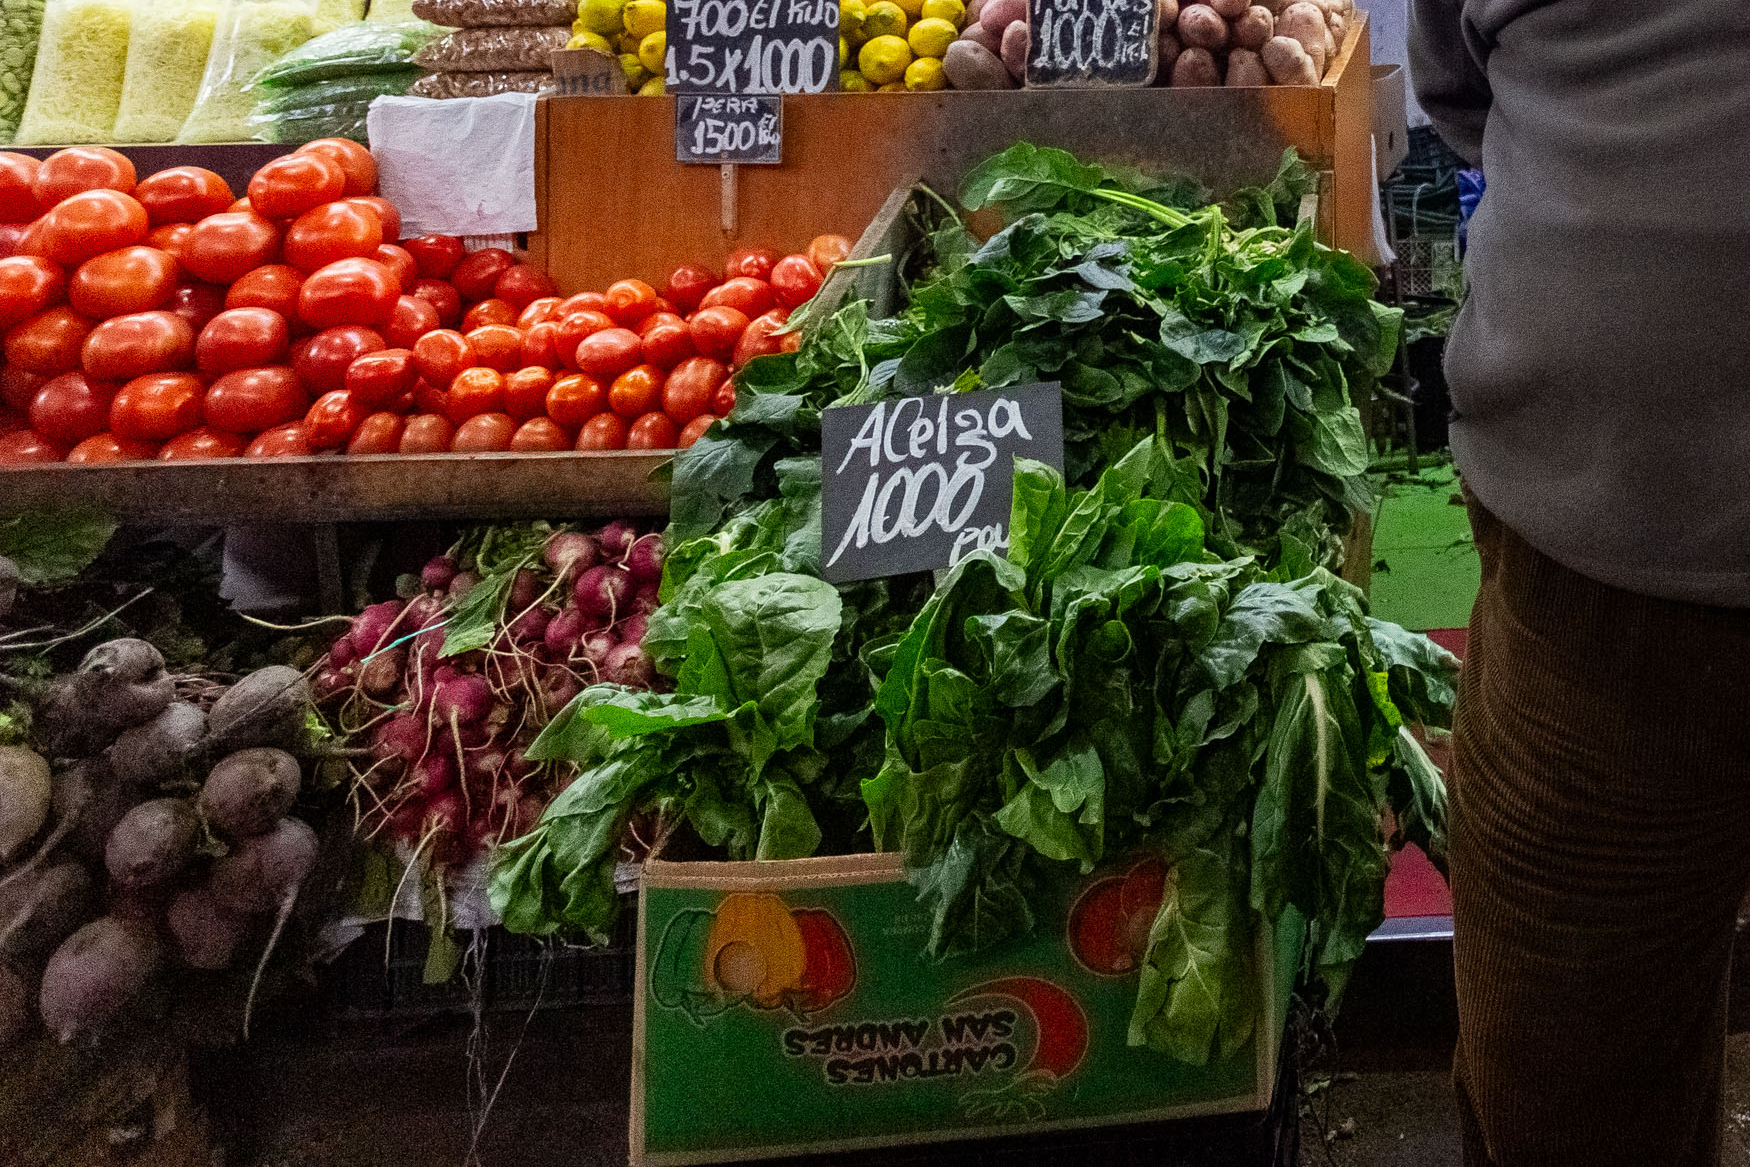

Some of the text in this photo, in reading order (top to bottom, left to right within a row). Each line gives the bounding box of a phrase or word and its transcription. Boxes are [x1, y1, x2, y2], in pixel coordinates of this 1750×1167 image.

[1032, 8, 1123, 71] 1000
[692, 96, 759, 122] PERA
[690, 118, 757, 155] 1500
[825, 461, 986, 568] 1000
[783, 1010, 1018, 1056] SAN ANDRES
[825, 1042, 1018, 1085] CARTONES
